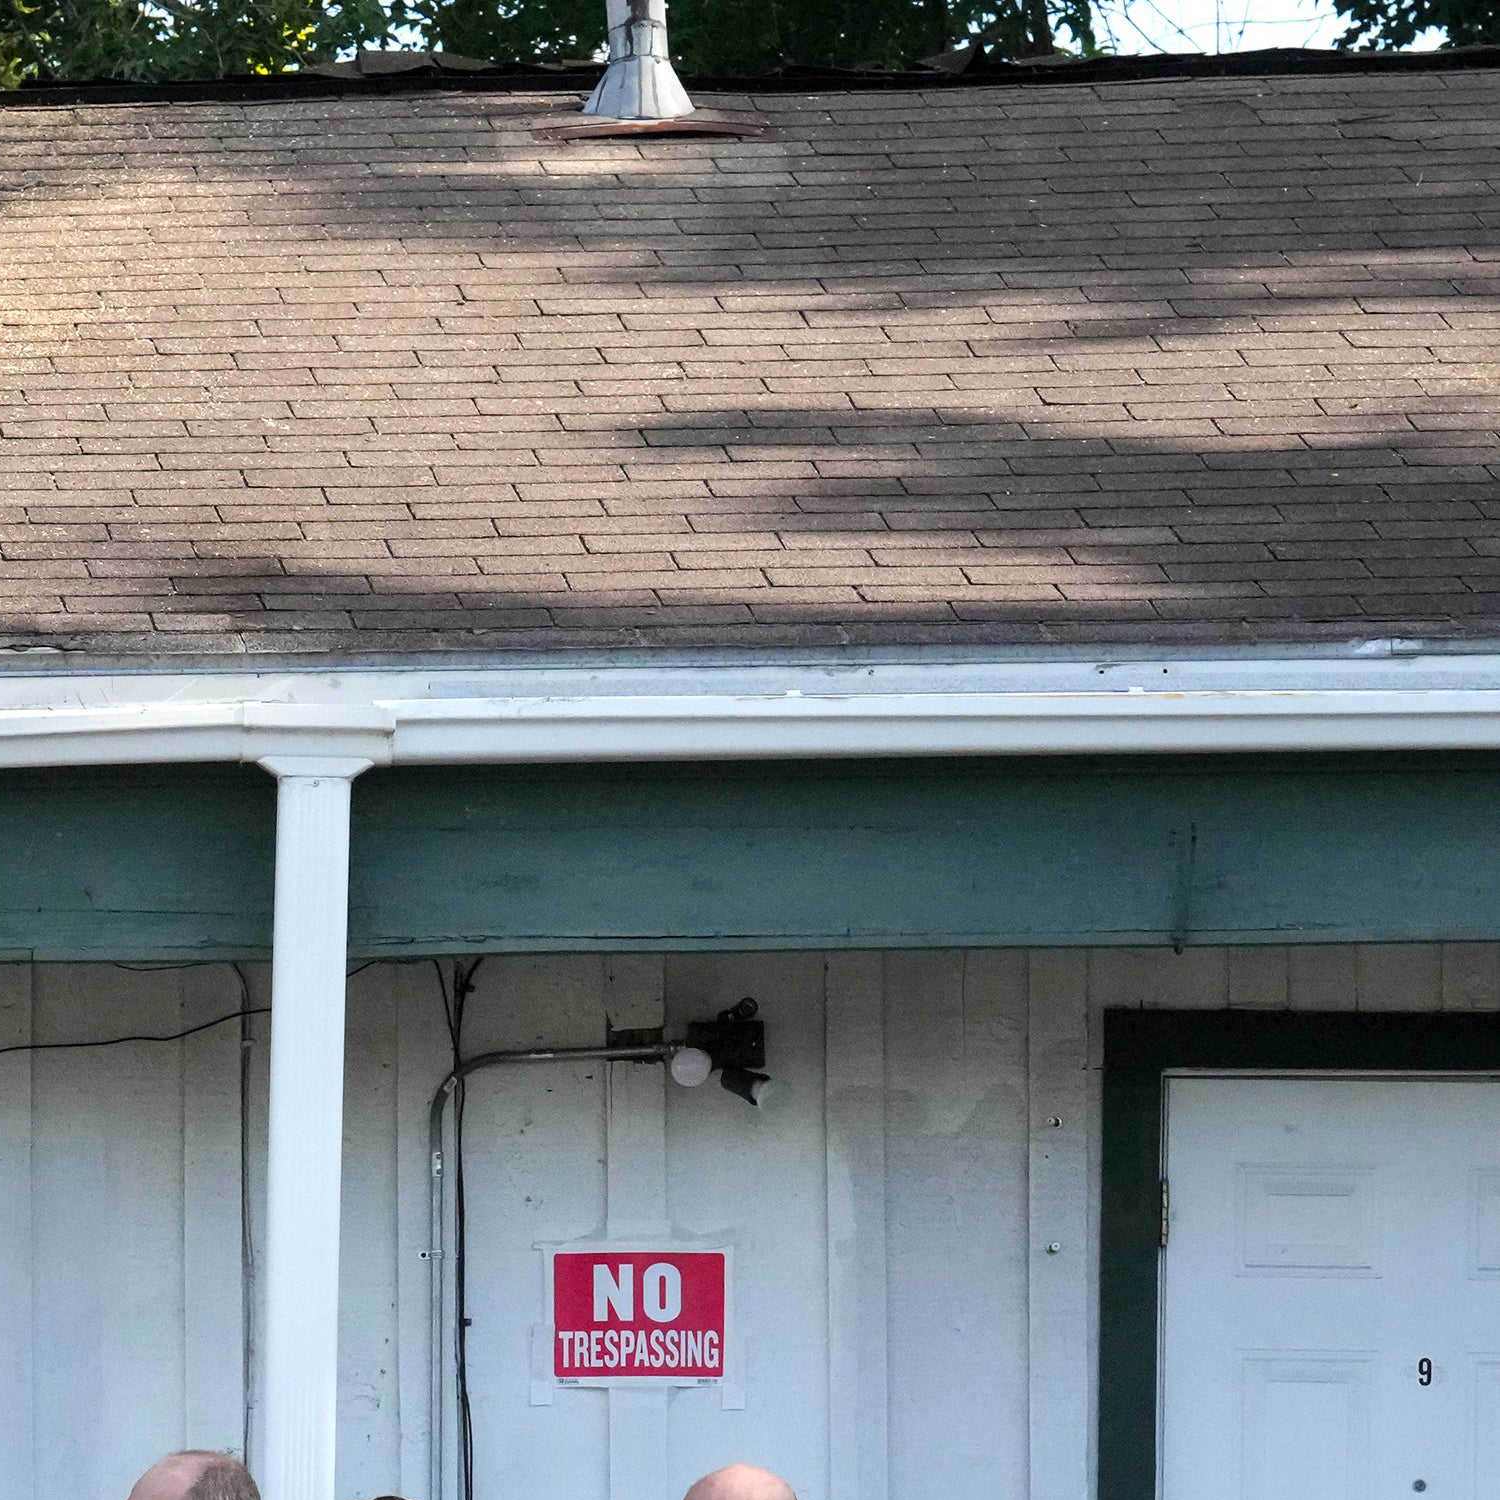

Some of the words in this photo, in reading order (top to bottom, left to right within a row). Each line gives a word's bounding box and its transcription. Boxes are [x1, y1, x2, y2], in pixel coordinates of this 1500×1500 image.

[593, 1262, 682, 1323] NO
[558, 1329, 720, 1369] TRESPASSING
[1418, 1357, 1432, 1386] 9
